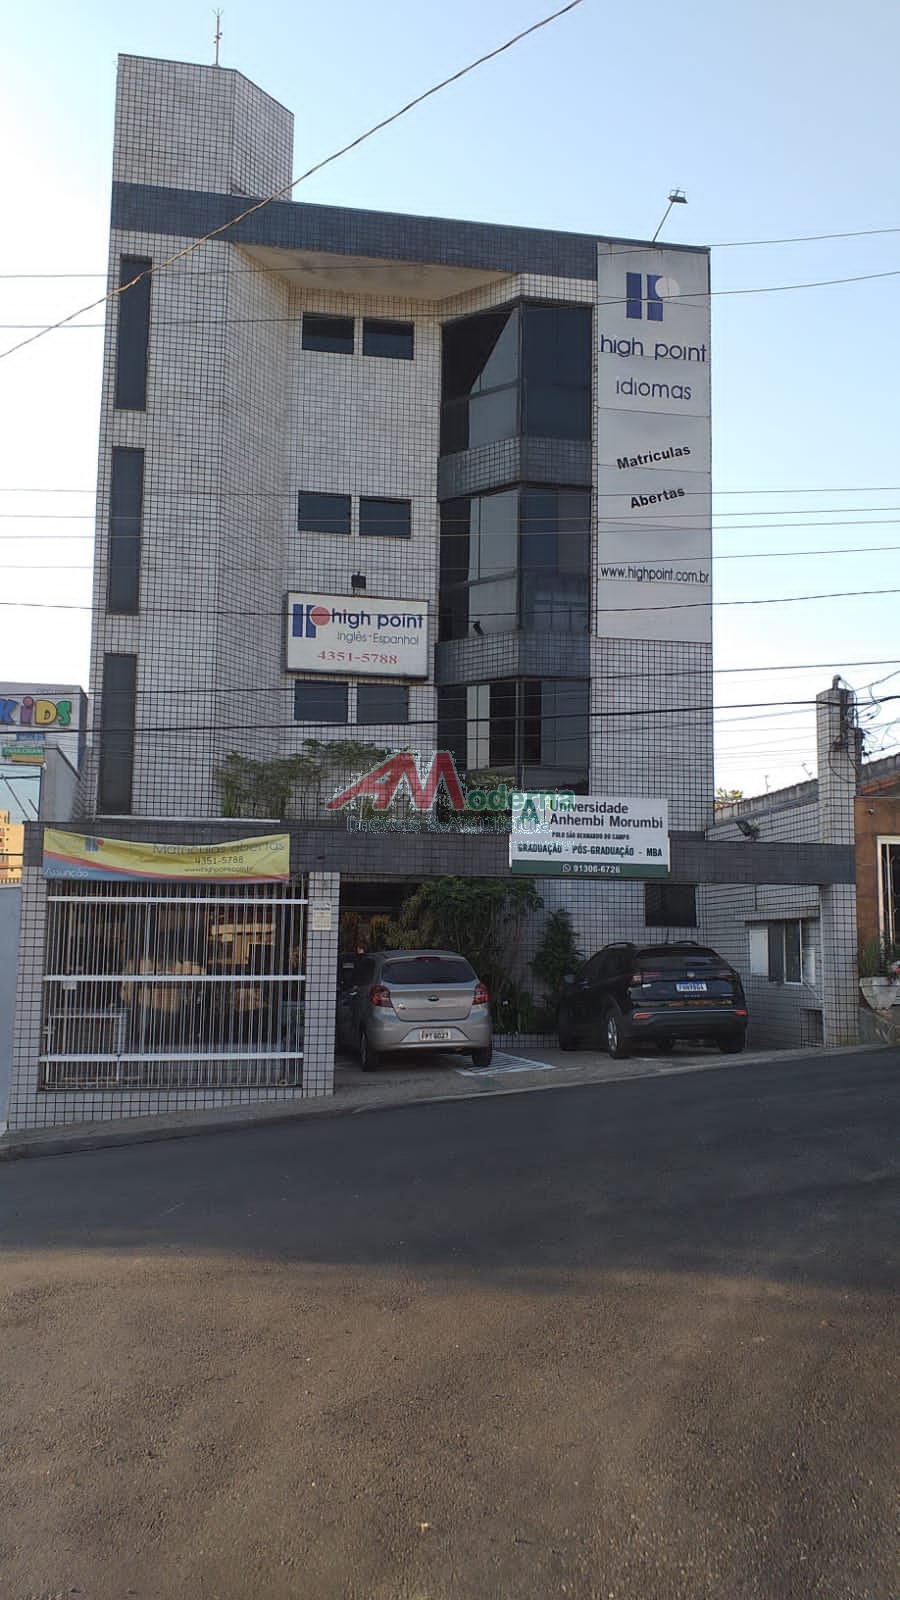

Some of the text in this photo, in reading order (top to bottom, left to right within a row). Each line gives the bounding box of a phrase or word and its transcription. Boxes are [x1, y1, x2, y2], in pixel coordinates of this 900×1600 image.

[600, 333, 707, 362] high point
[616, 376, 692, 400] idiomas
[630, 487, 686, 509] Abertas
[600, 565, 709, 583] www.highpoint.com.br
[331, 607, 424, 630] high point
[337, 631, 419, 646] Inglês Espanhol
[317, 650, 398, 665] 4351-5788
[550, 799, 629, 815] Universidade
[550, 814, 663, 829] Anhembi Morumbi
[517, 843, 562, 855] GRADUAÇÃO
[572, 845, 634, 857] PÓS-GRADUAÇÃO
[646, 848, 663, 857] MBA
